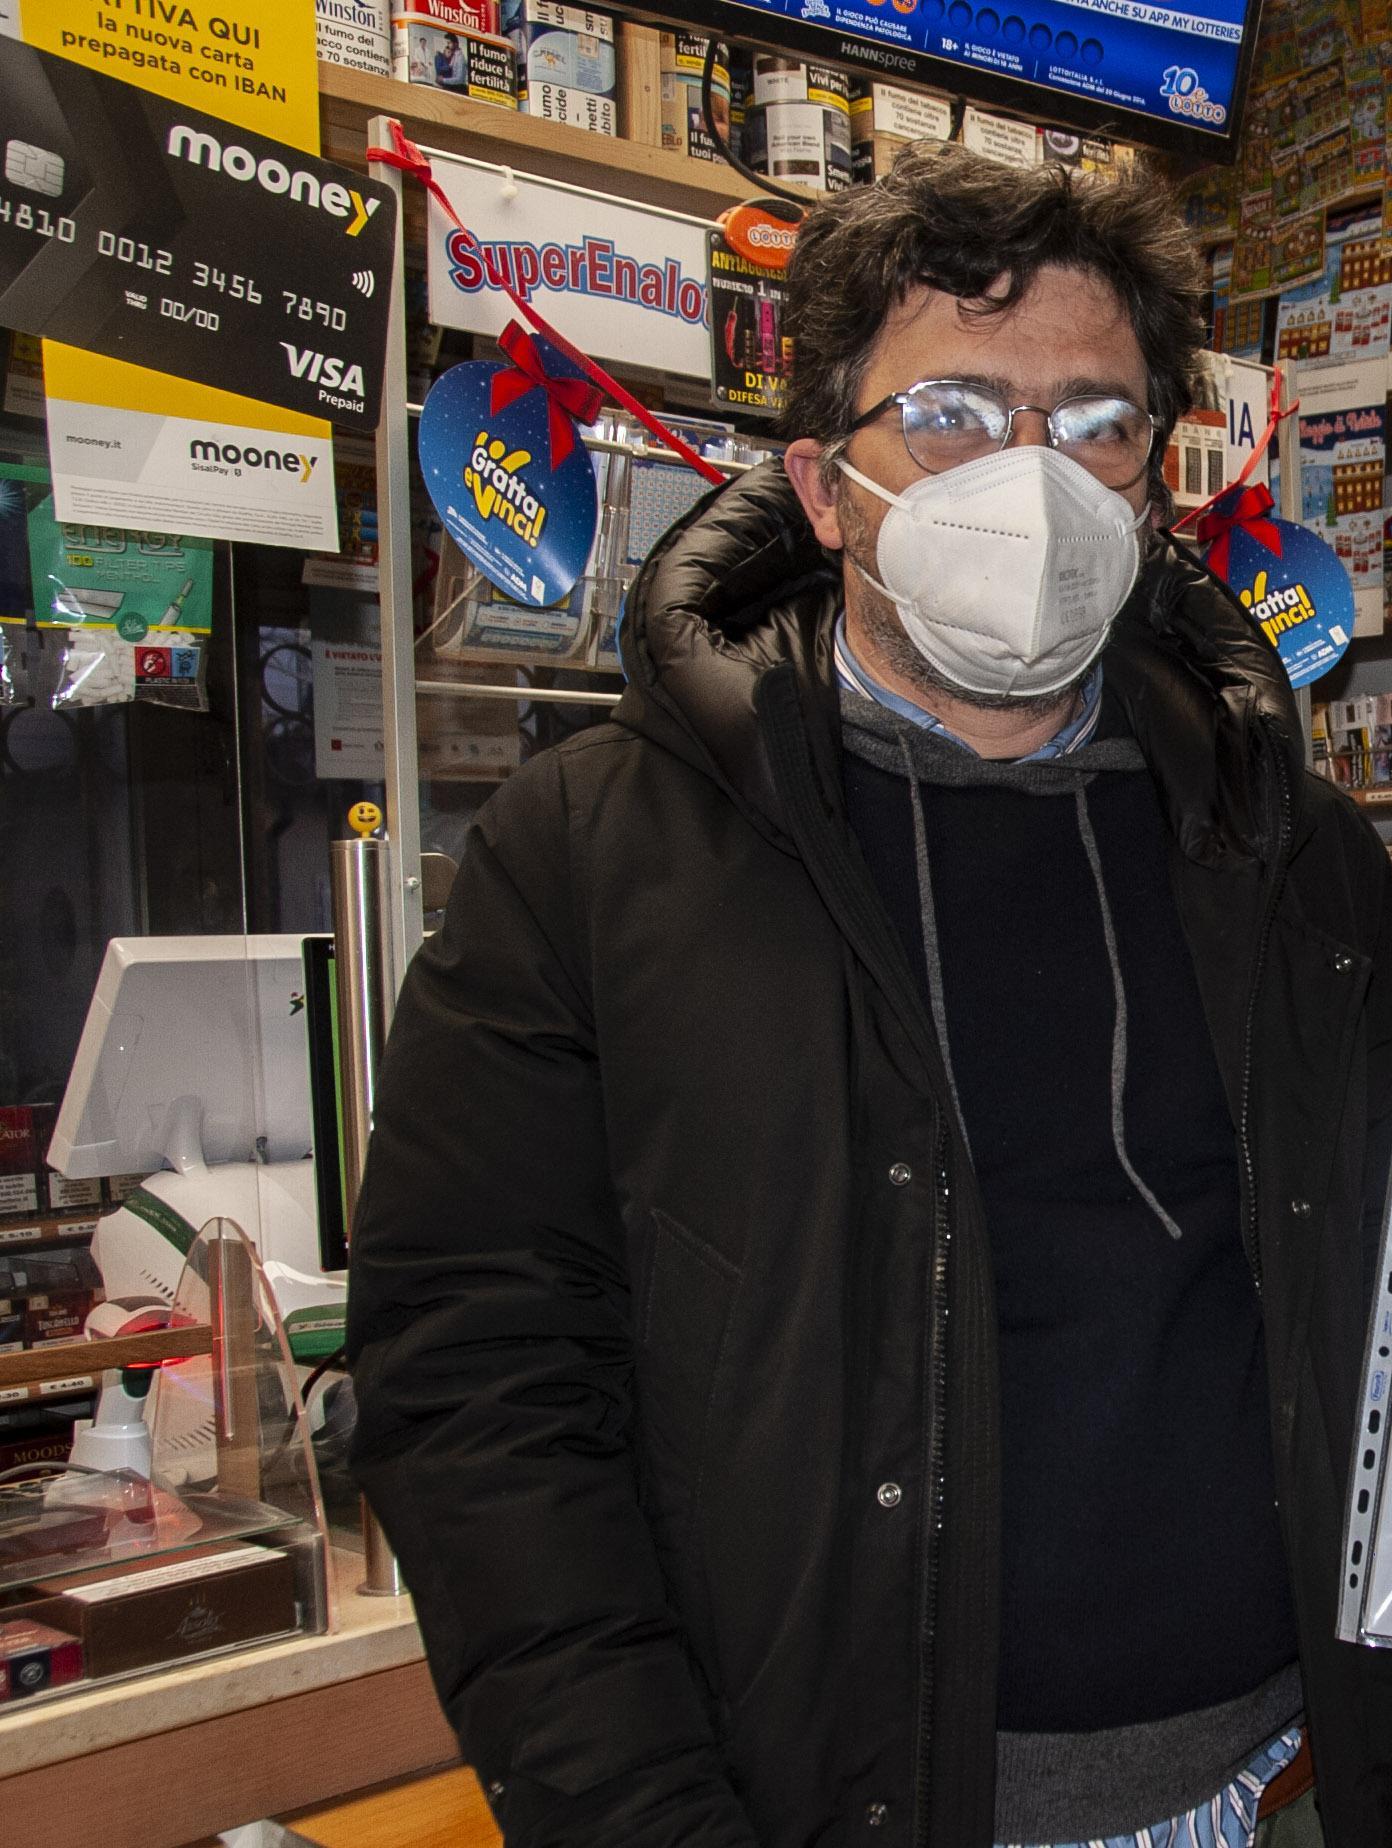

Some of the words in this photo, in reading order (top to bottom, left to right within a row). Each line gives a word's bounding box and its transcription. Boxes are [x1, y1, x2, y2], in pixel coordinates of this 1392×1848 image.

[316, 0, 375, 28] Winston
[428, 0, 479, 29] Winston
[1133, 8, 1147, 19] SU
[1150, 11, 1170, 25] APP
[1172, 15, 1190, 28] MY
[1191, 19, 1241, 40] LOTTERIES
[97, 11, 117, 32] la
[126, 23, 193, 54] nuova
[200, 45, 254, 71] carta
[209, 18, 260, 49] QUI
[358, 34, 374, 46] del
[941, 38, 959, 51] 18+
[62, 30, 181, 74] prepagata
[189, 66, 227, 87] con
[235, 75, 286, 103] IBAN
[327, 51, 340, 63] 70
[470, 42, 477, 54] Il
[479, 44, 507, 63] fumo
[841, 42, 916, 72] HANNspree
[470, 58, 503, 76] riduce
[505, 65, 513, 80] la
[470, 70, 511, 92] fertilità
[1049, 65, 1088, 81] LOTTOITALIA
[1160, 65, 1199, 97] 10
[1169, 94, 1226, 124] LOTTO
[167, 124, 381, 237] mooney
[98, 230, 173, 276] 0012
[193, 262, 262, 305] 3456
[283, 291, 347, 331] 7890
[445, 227, 711, 332] SuperEnalo
[757, 279, 766, 297] 1
[160, 298, 219, 331] 00/00
[279, 342, 365, 397] VISA
[319, 390, 364, 413] Prepaid
[728, 389, 767, 406] DIFESA
[66, 434, 121, 450] mooney.it
[190, 439, 318, 483] mooney
[192, 463, 229, 477] SisalPay
[471, 447, 539, 520] Gratta
[464, 467, 472, 488] e
[472, 472, 546, 548] Vinci!
[13, 1443, 73, 1464] MOODS
